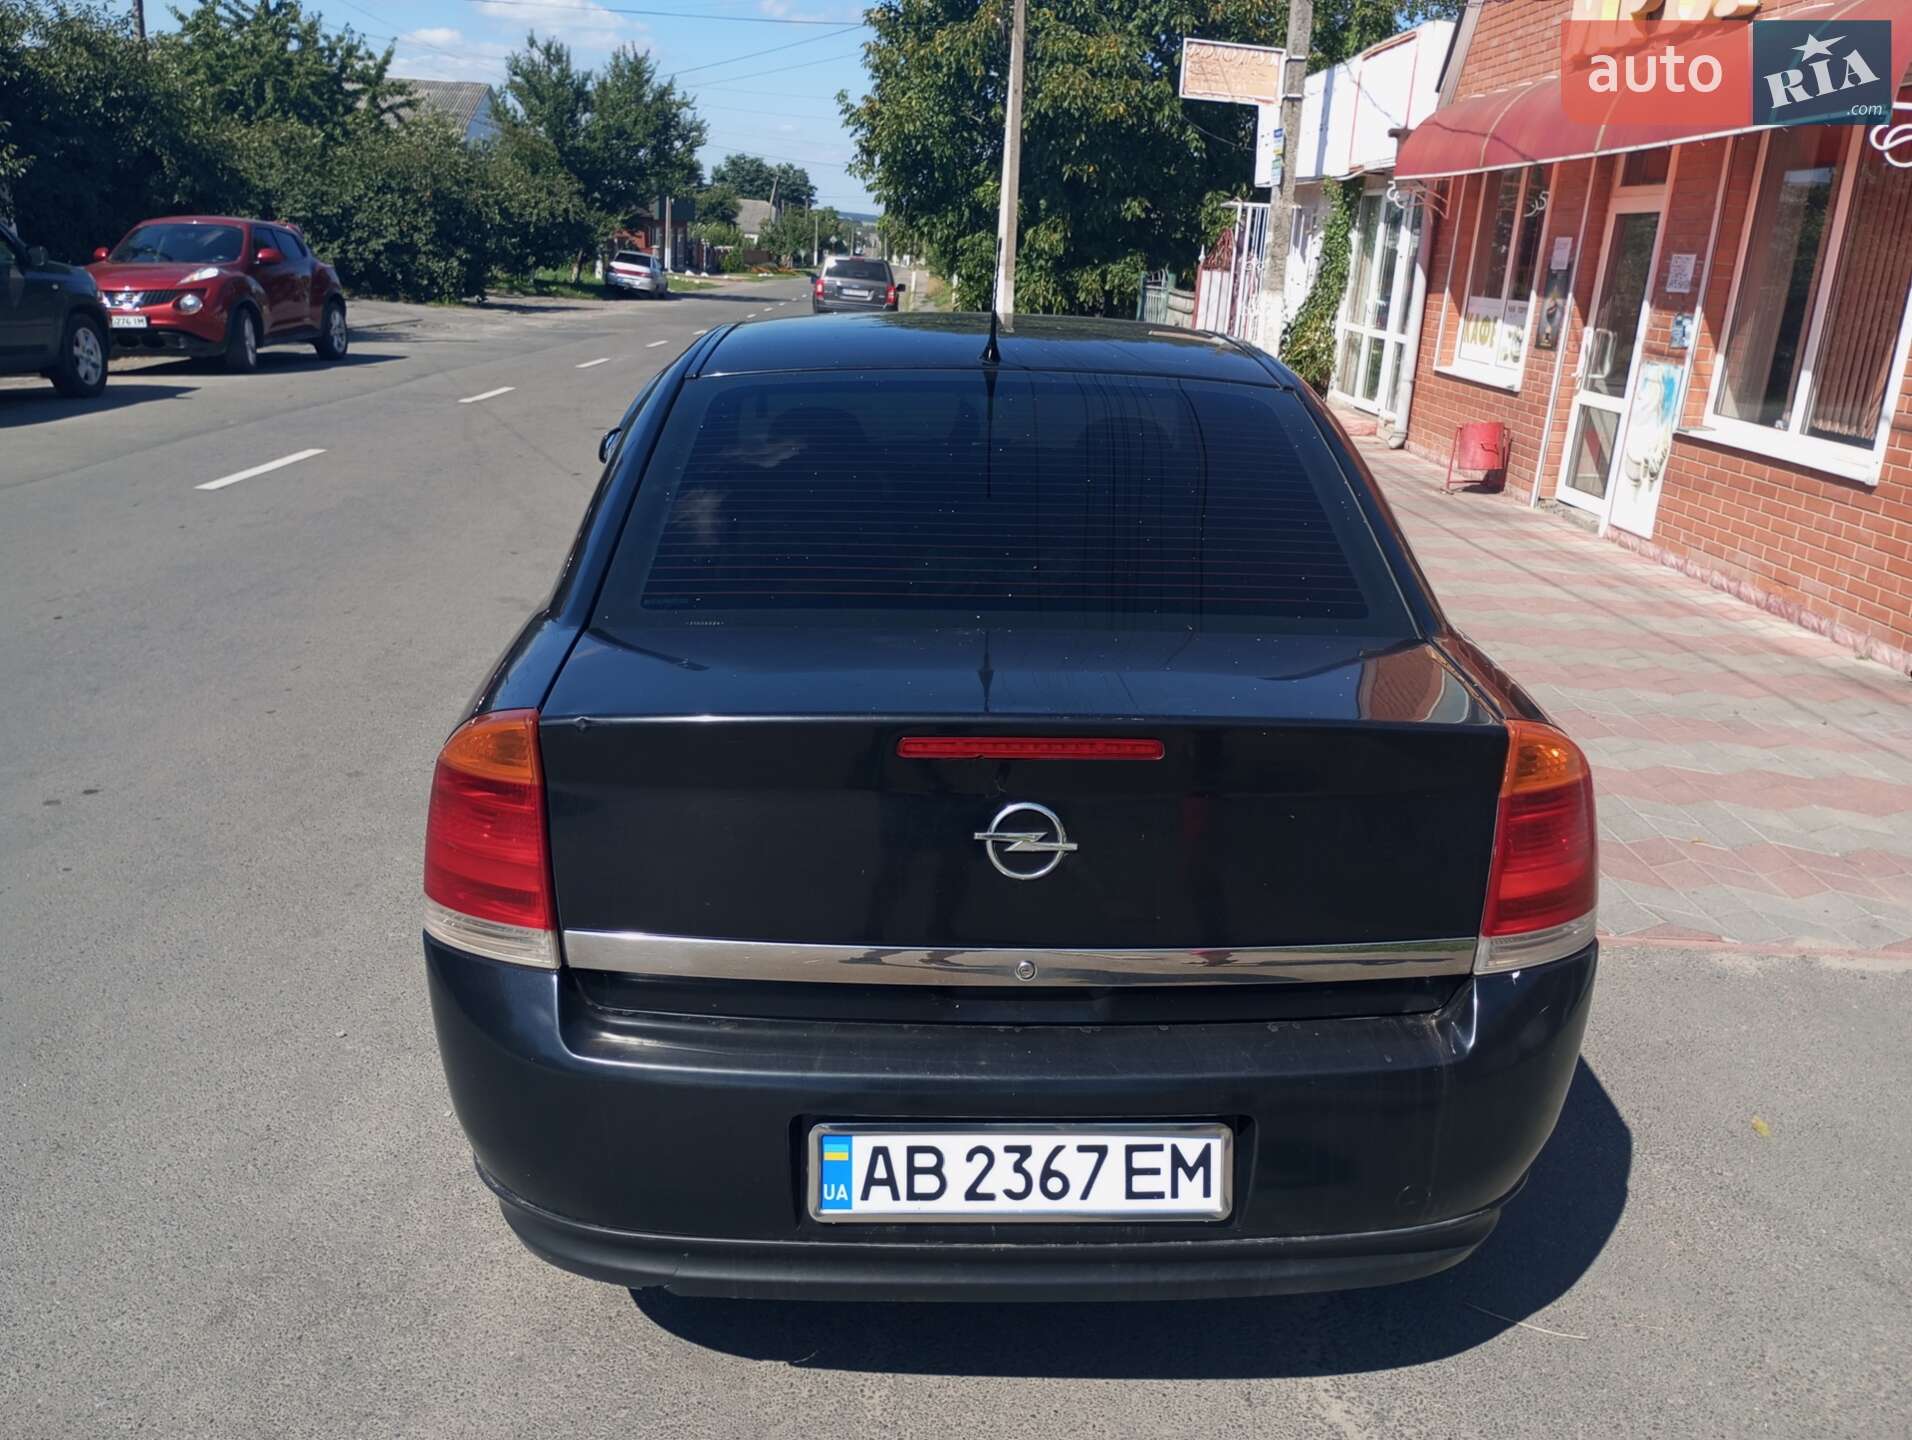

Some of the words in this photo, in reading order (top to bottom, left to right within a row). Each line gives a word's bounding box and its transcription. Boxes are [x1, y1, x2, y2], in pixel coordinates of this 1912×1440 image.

[860, 1145, 948, 1202] AB
[963, 1144, 1109, 1202] 2367
[1124, 1143, 1212, 1200] EM
[823, 1183, 849, 1201] UA
